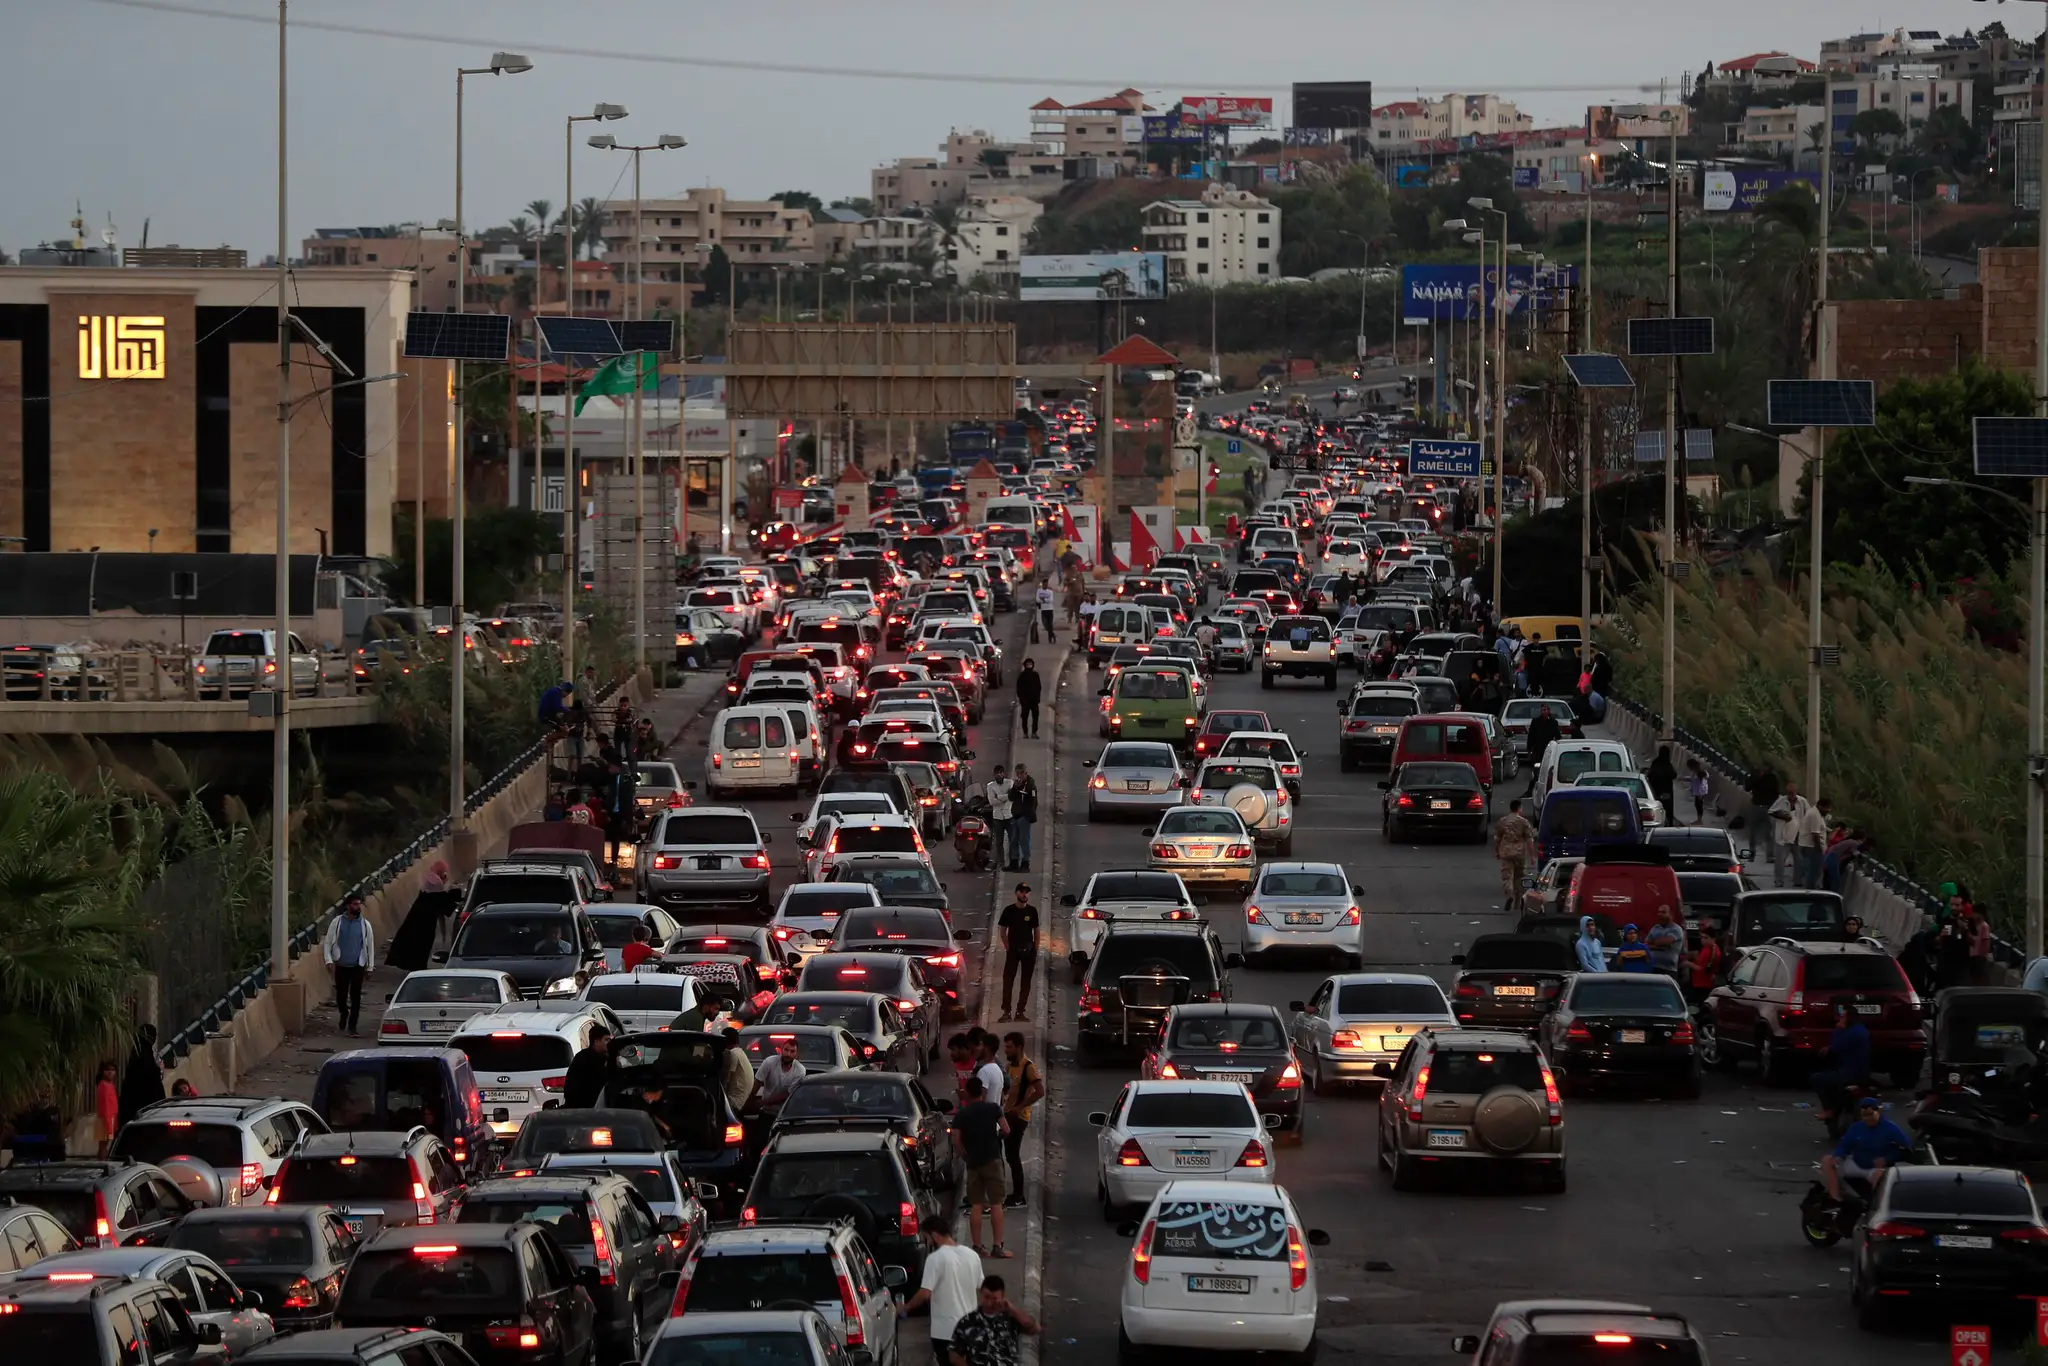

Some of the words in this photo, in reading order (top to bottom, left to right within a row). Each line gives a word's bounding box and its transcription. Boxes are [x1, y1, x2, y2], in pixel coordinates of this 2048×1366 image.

[1417, 443, 1472, 459] الرميلة
[1417, 461, 1472, 472] RMEILEH
[1431, 1135, 1464, 1145] S195147
[1176, 1156, 1210, 1166] N145560
[1163, 1239, 1197, 1248] ALBABA
[1196, 1279, 1204, 1289] M
[1209, 1279, 1243, 1291] 188994
[1955, 1331, 1986, 1344] OPEN
